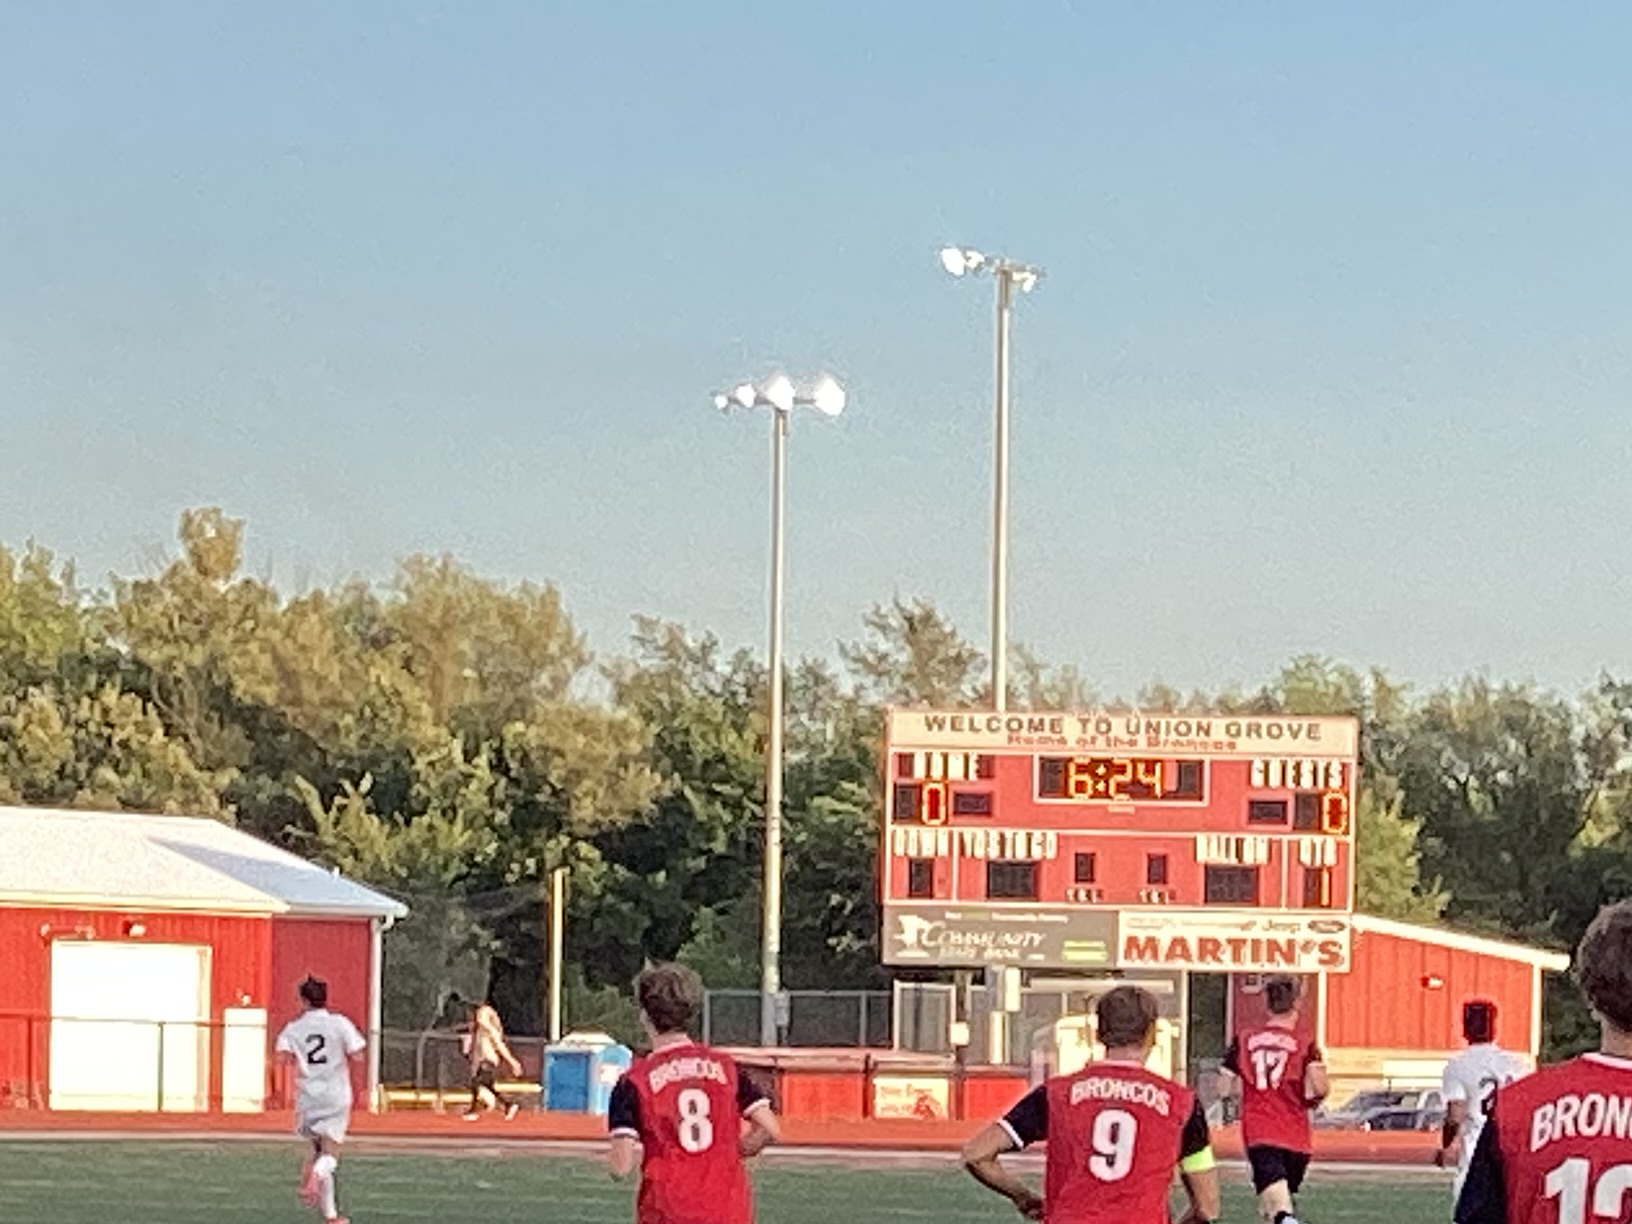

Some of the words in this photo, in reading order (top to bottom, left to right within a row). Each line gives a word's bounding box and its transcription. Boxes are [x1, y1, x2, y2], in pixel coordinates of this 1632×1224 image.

[924, 715, 1064, 733] WELCOME
[1077, 717, 1113, 735] TO
[1126, 719, 1213, 738] UNION
[1225, 721, 1322, 741] GROVE
[1069, 756, 1162, 801] 6:24
[922, 781, 946, 825] 0
[1322, 790, 1348, 833] 0
[1123, 935, 1345, 967] MARTIN'S
[305, 1034, 327, 1064] 2
[1250, 1048, 1289, 1090] 17
[1070, 1077, 1170, 1117] BRONCOS
[677, 1088, 713, 1153] 8
[1089, 1107, 1138, 1182] 9
